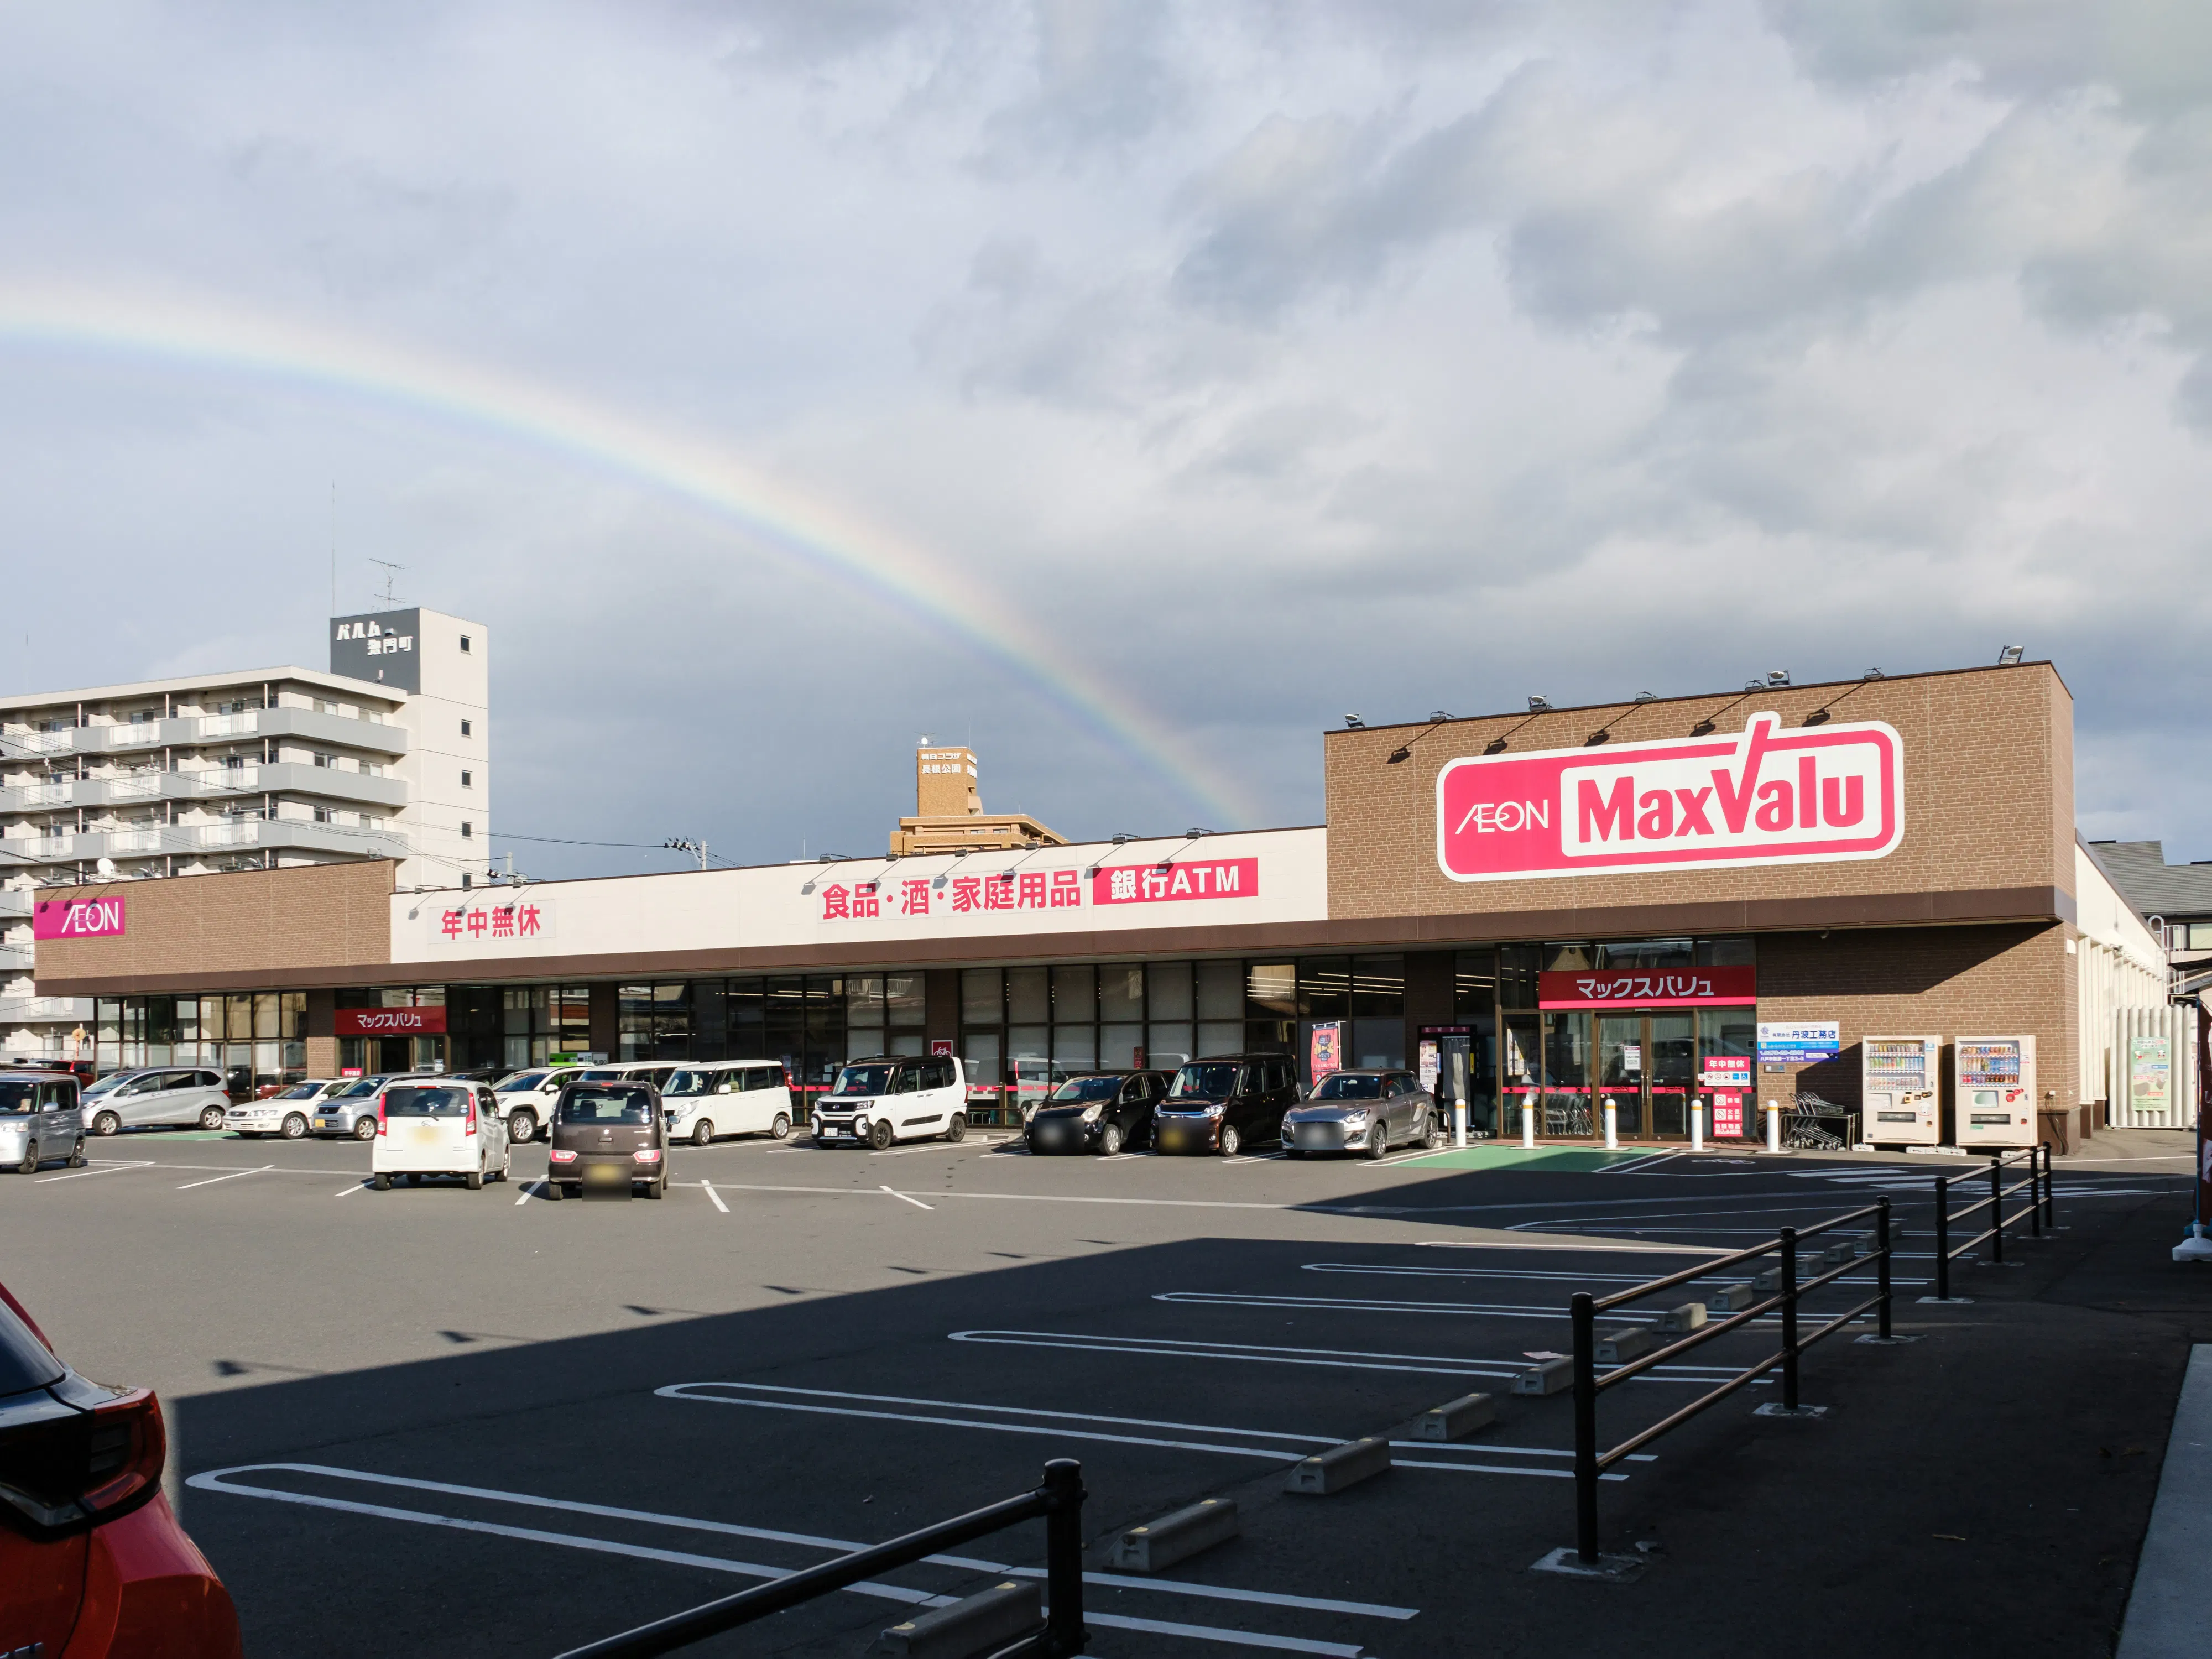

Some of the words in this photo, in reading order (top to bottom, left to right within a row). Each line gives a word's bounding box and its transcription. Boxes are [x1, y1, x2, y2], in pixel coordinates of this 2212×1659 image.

[336, 620, 382, 641] パルム
[921, 764, 961, 774] 長根公園
[1577, 719, 1865, 843] MaxValu
[1110, 865, 1240, 900] 銀行ATM
[822, 869, 1082, 921] 食品・酒・家庭用品
[441, 904, 541, 940] 年中無休
[1576, 975, 1714, 999] マックスバリュ
[357, 1013, 422, 1029] マックスバリュ
[1791, 1030, 1836, 1039] 丹波工務店
[1709, 1060, 1745, 1068] 年中無休
